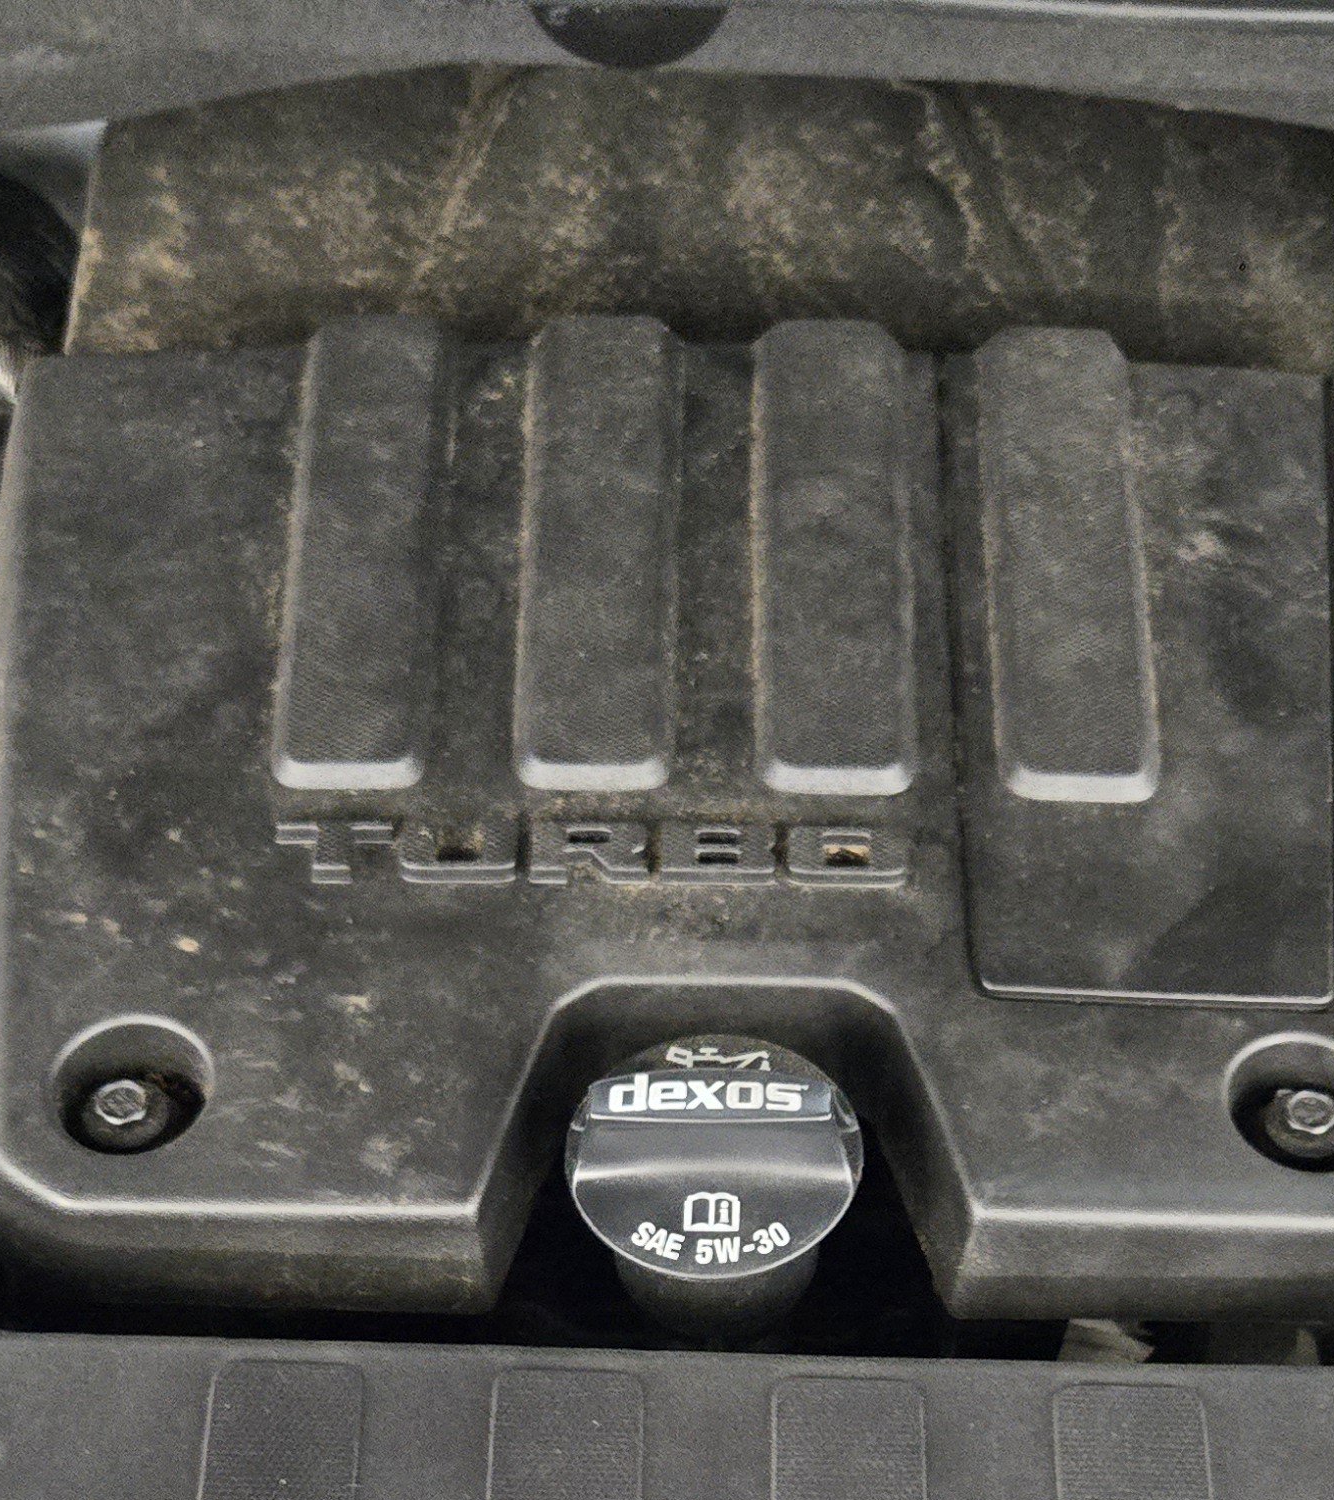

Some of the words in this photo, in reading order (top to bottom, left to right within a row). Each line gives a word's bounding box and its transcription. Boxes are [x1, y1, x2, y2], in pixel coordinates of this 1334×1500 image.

[274, 819, 906, 888] TURBO
[608, 1073, 805, 1113] dexos
[630, 1221, 686, 1261] SAE
[694, 1221, 791, 1265] 5W-30
